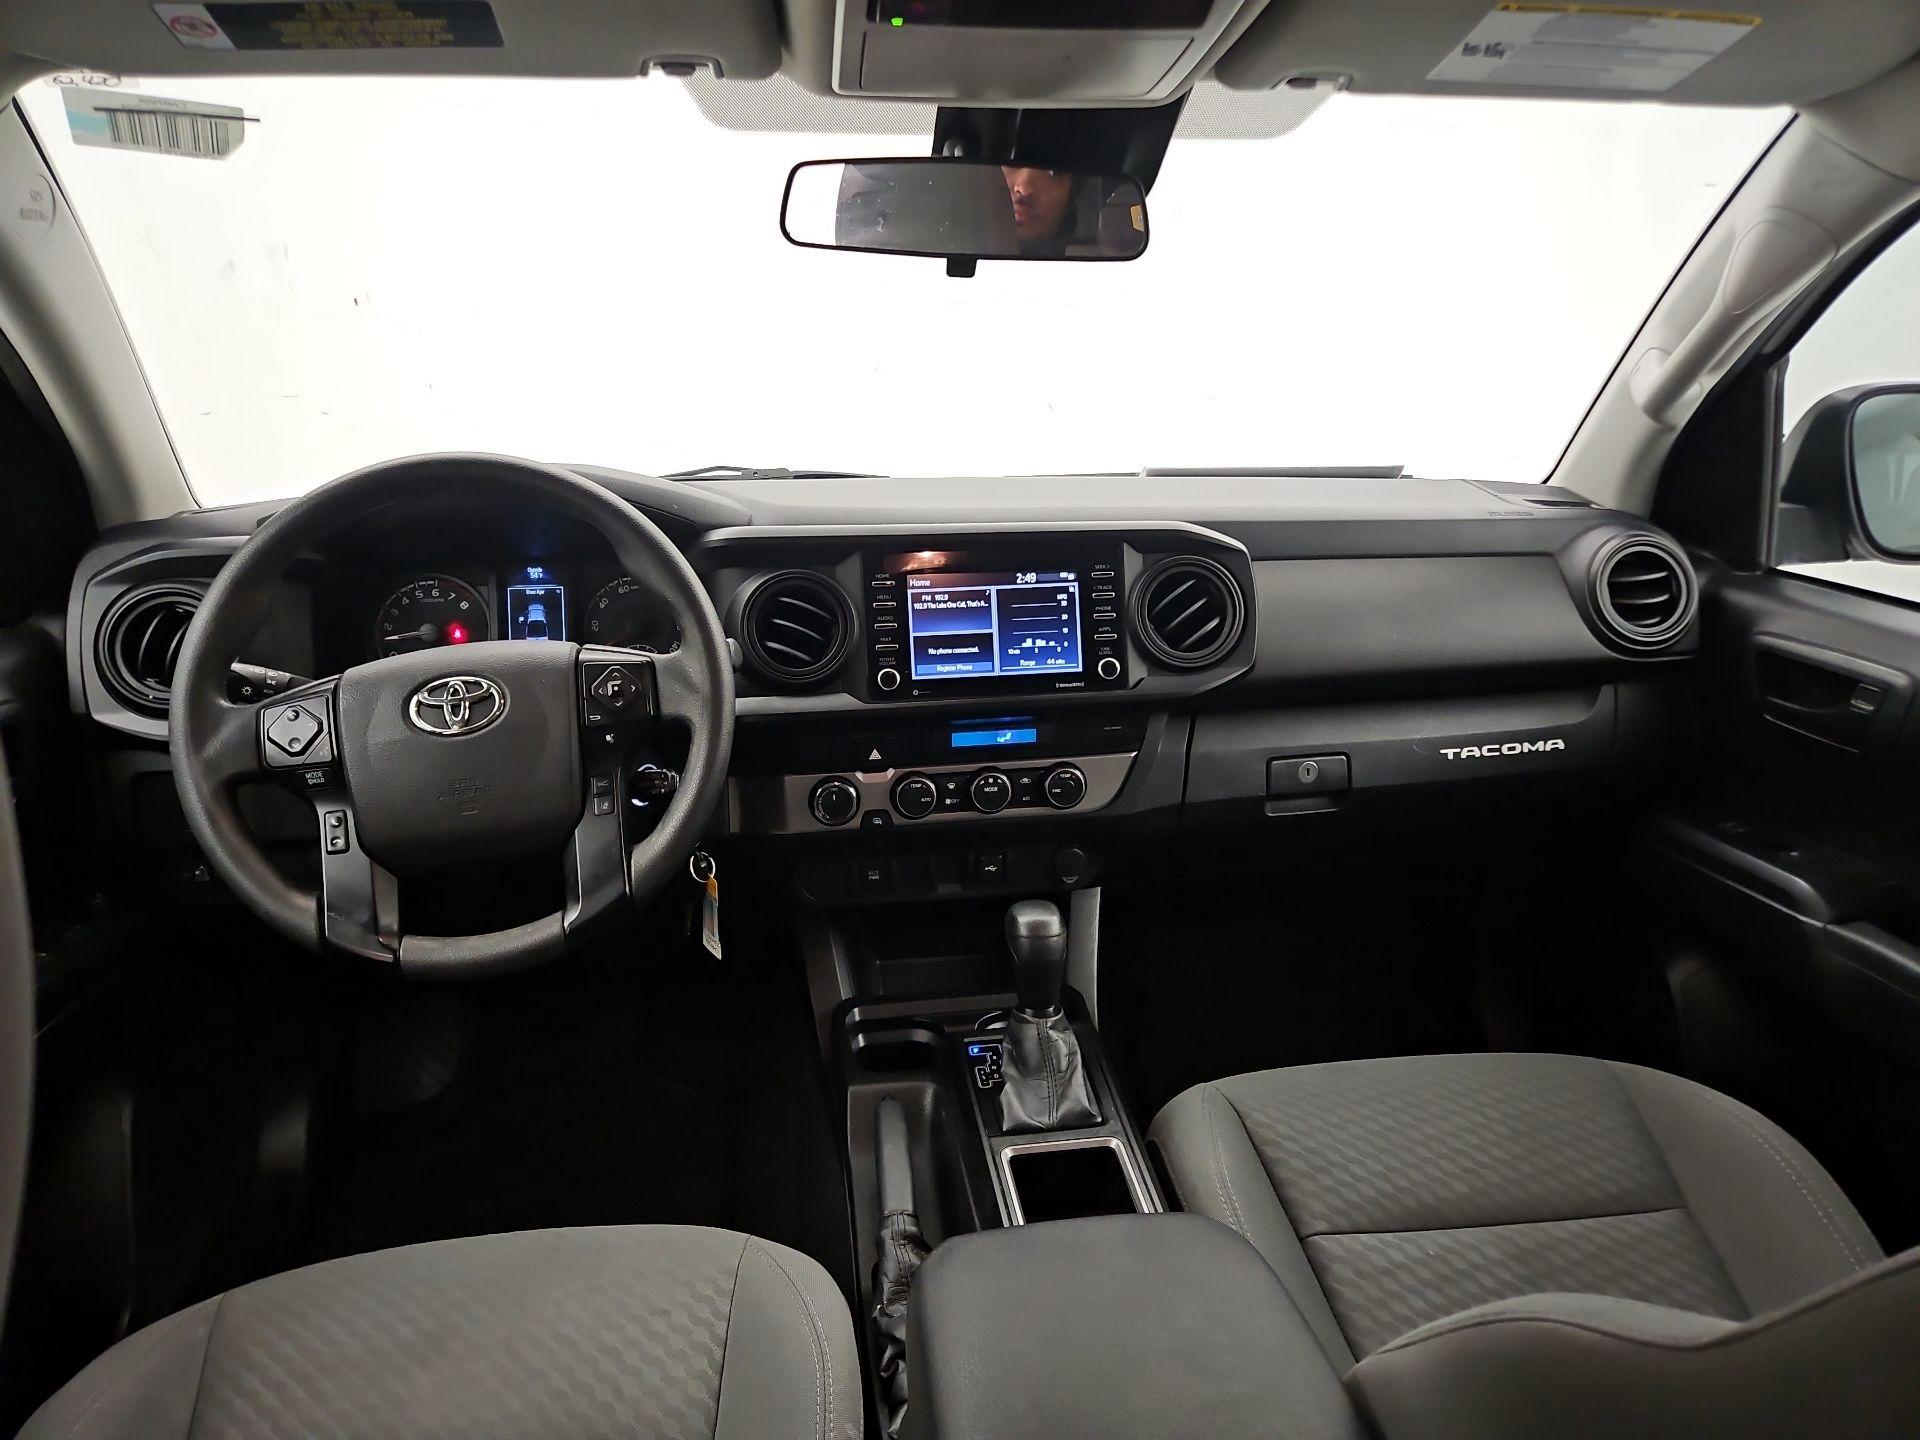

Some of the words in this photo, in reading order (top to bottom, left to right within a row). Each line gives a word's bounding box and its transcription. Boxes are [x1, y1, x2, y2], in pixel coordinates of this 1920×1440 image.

[909, 578, 931, 587] Home
[1016, 572, 1037, 584] 2:49
[415, 590, 424, 598] 5
[431, 588, 440, 597] 6
[447, 592, 456, 600] 7
[402, 596, 410, 605] 4
[934, 593, 949, 601] 102.9
[460, 600, 470, 610] 8
[913, 602, 928, 610] 102.9
[936, 647, 953, 655] phone
[1019, 659, 1036, 667] Range
[936, 665, 957, 673] Register
[1439, 738, 1566, 760] TACOMA
[305, 770, 324, 779] MODE
